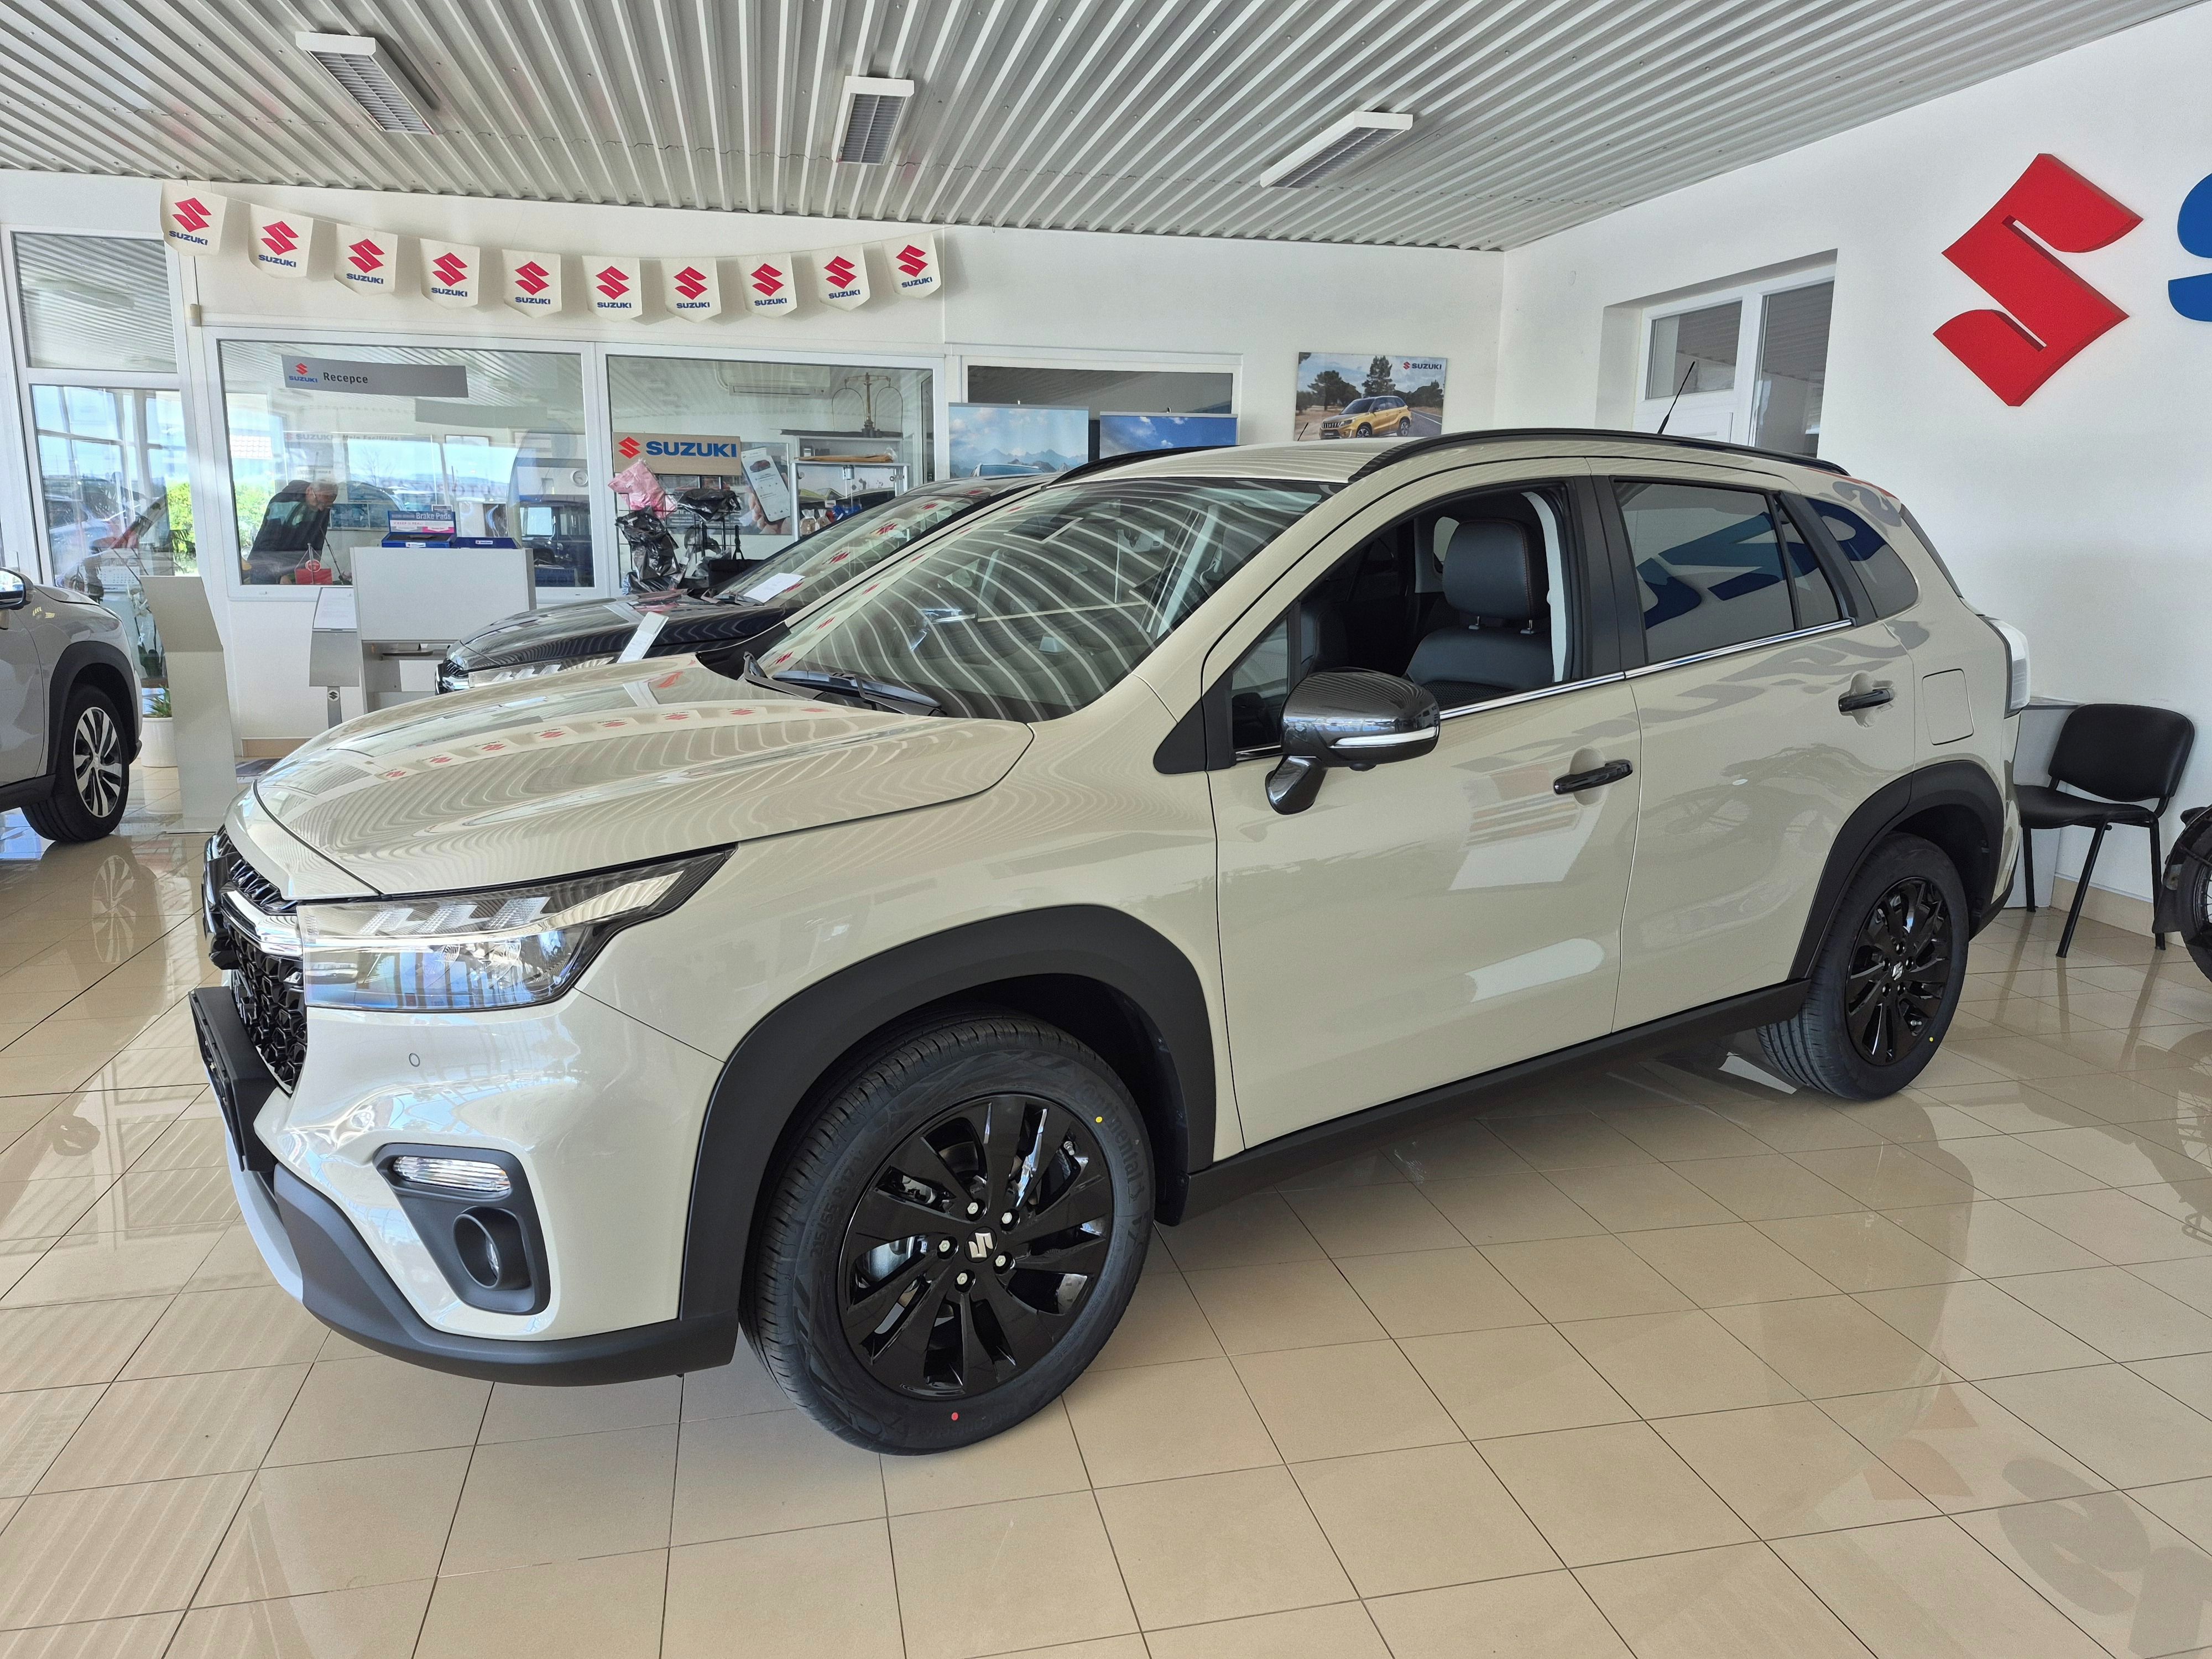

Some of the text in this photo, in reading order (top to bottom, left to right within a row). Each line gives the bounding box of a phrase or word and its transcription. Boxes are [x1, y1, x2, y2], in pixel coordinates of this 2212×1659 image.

[168, 230, 208, 246] SUZUKI
[258, 254, 297, 268] SUZUKI
[346, 273, 384, 285] SUZUKI
[901, 276, 933, 288] SUZUKI
[430, 286, 468, 298] SUZUKI
[828, 289, 860, 299] SUZUKI
[514, 296, 551, 305] SUZUKI
[754, 298, 787, 307] SUZUKI
[322, 372, 368, 384] Recepce
[645, 440, 737, 458] SUZUKI
[1075, 1079, 1145, 1183] Continental
[809, 1203, 838, 1258] 215/55
[832, 1186, 847, 1199] R
[841, 1167, 855, 1183] 17
